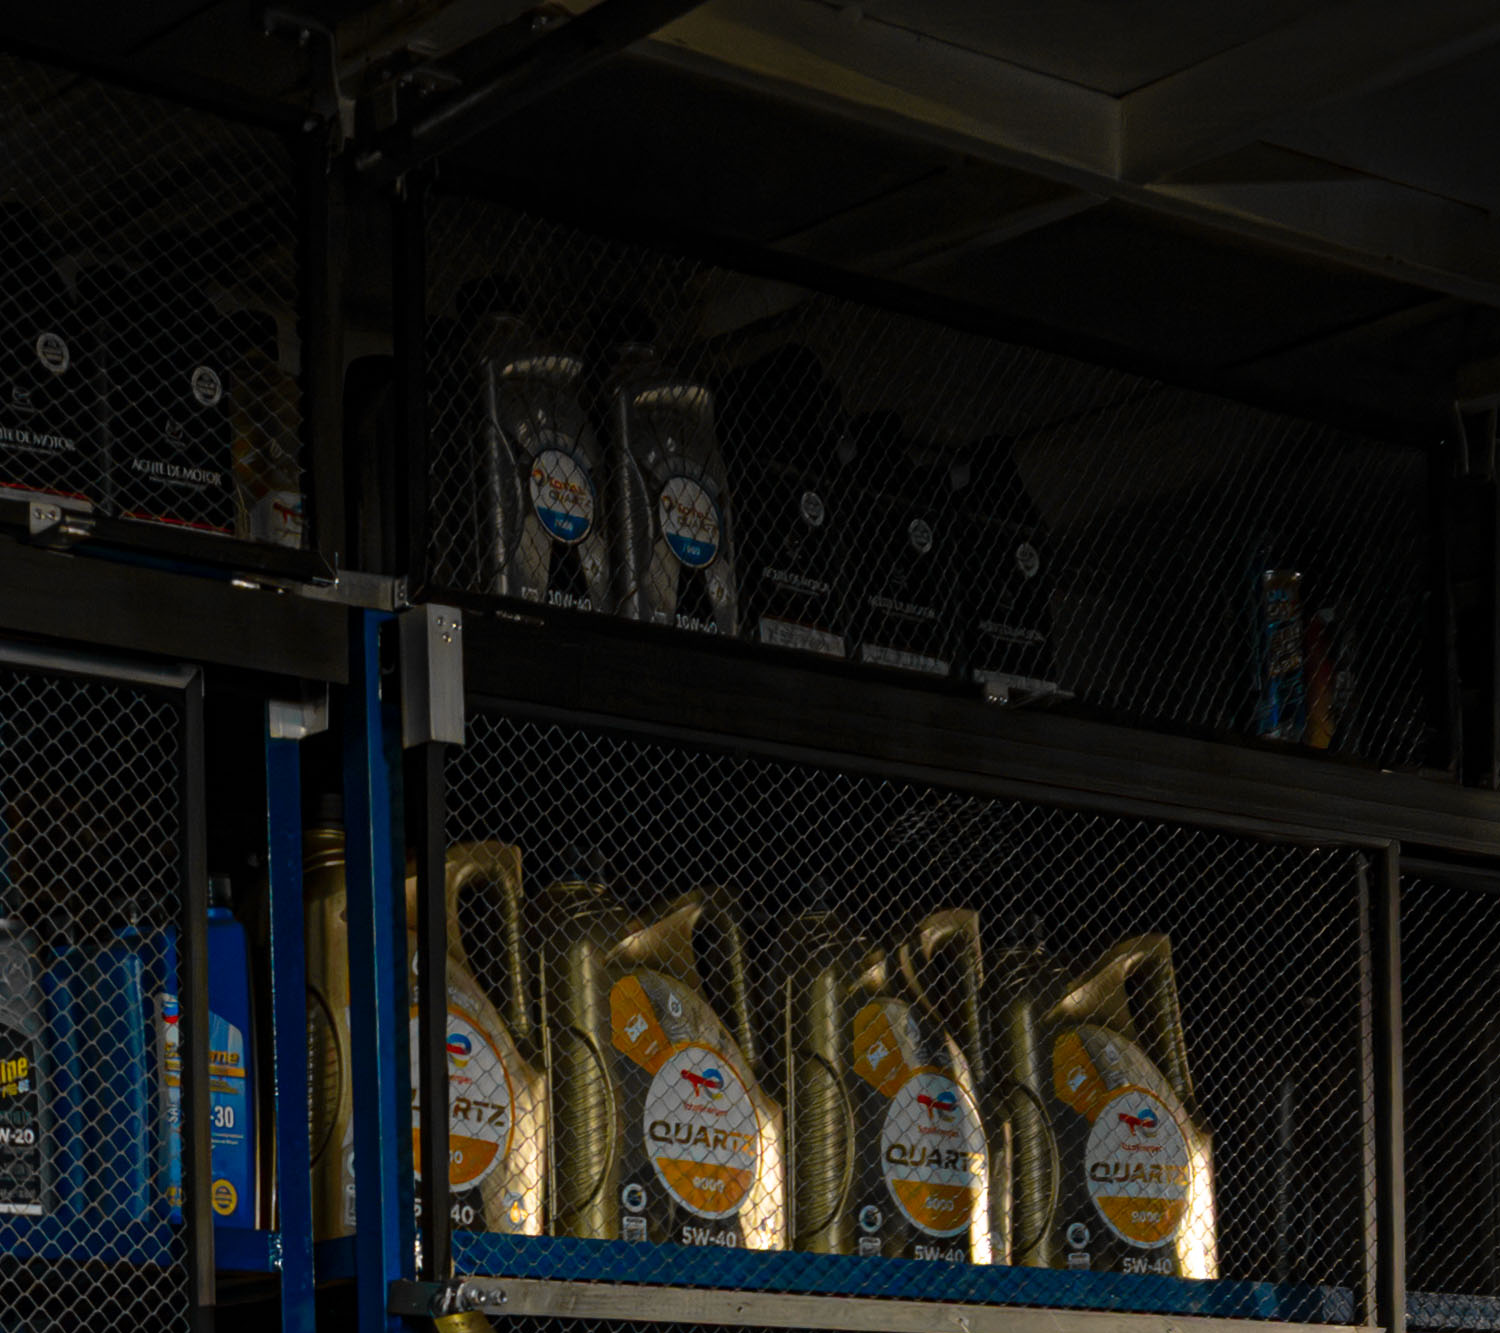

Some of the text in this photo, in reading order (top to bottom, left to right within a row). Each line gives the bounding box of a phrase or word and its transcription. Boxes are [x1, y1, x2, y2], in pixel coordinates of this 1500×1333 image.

[648, 1119, 758, 1157] QUARTZ
[885, 1143, 985, 1176] QUARTZ
[1090, 1160, 1190, 1186] QUARTZ
[681, 1223, 737, 1248] 5W-40
[914, 1244, 965, 1264] 5W-40
[1122, 1256, 1172, 1276] 5W-40
